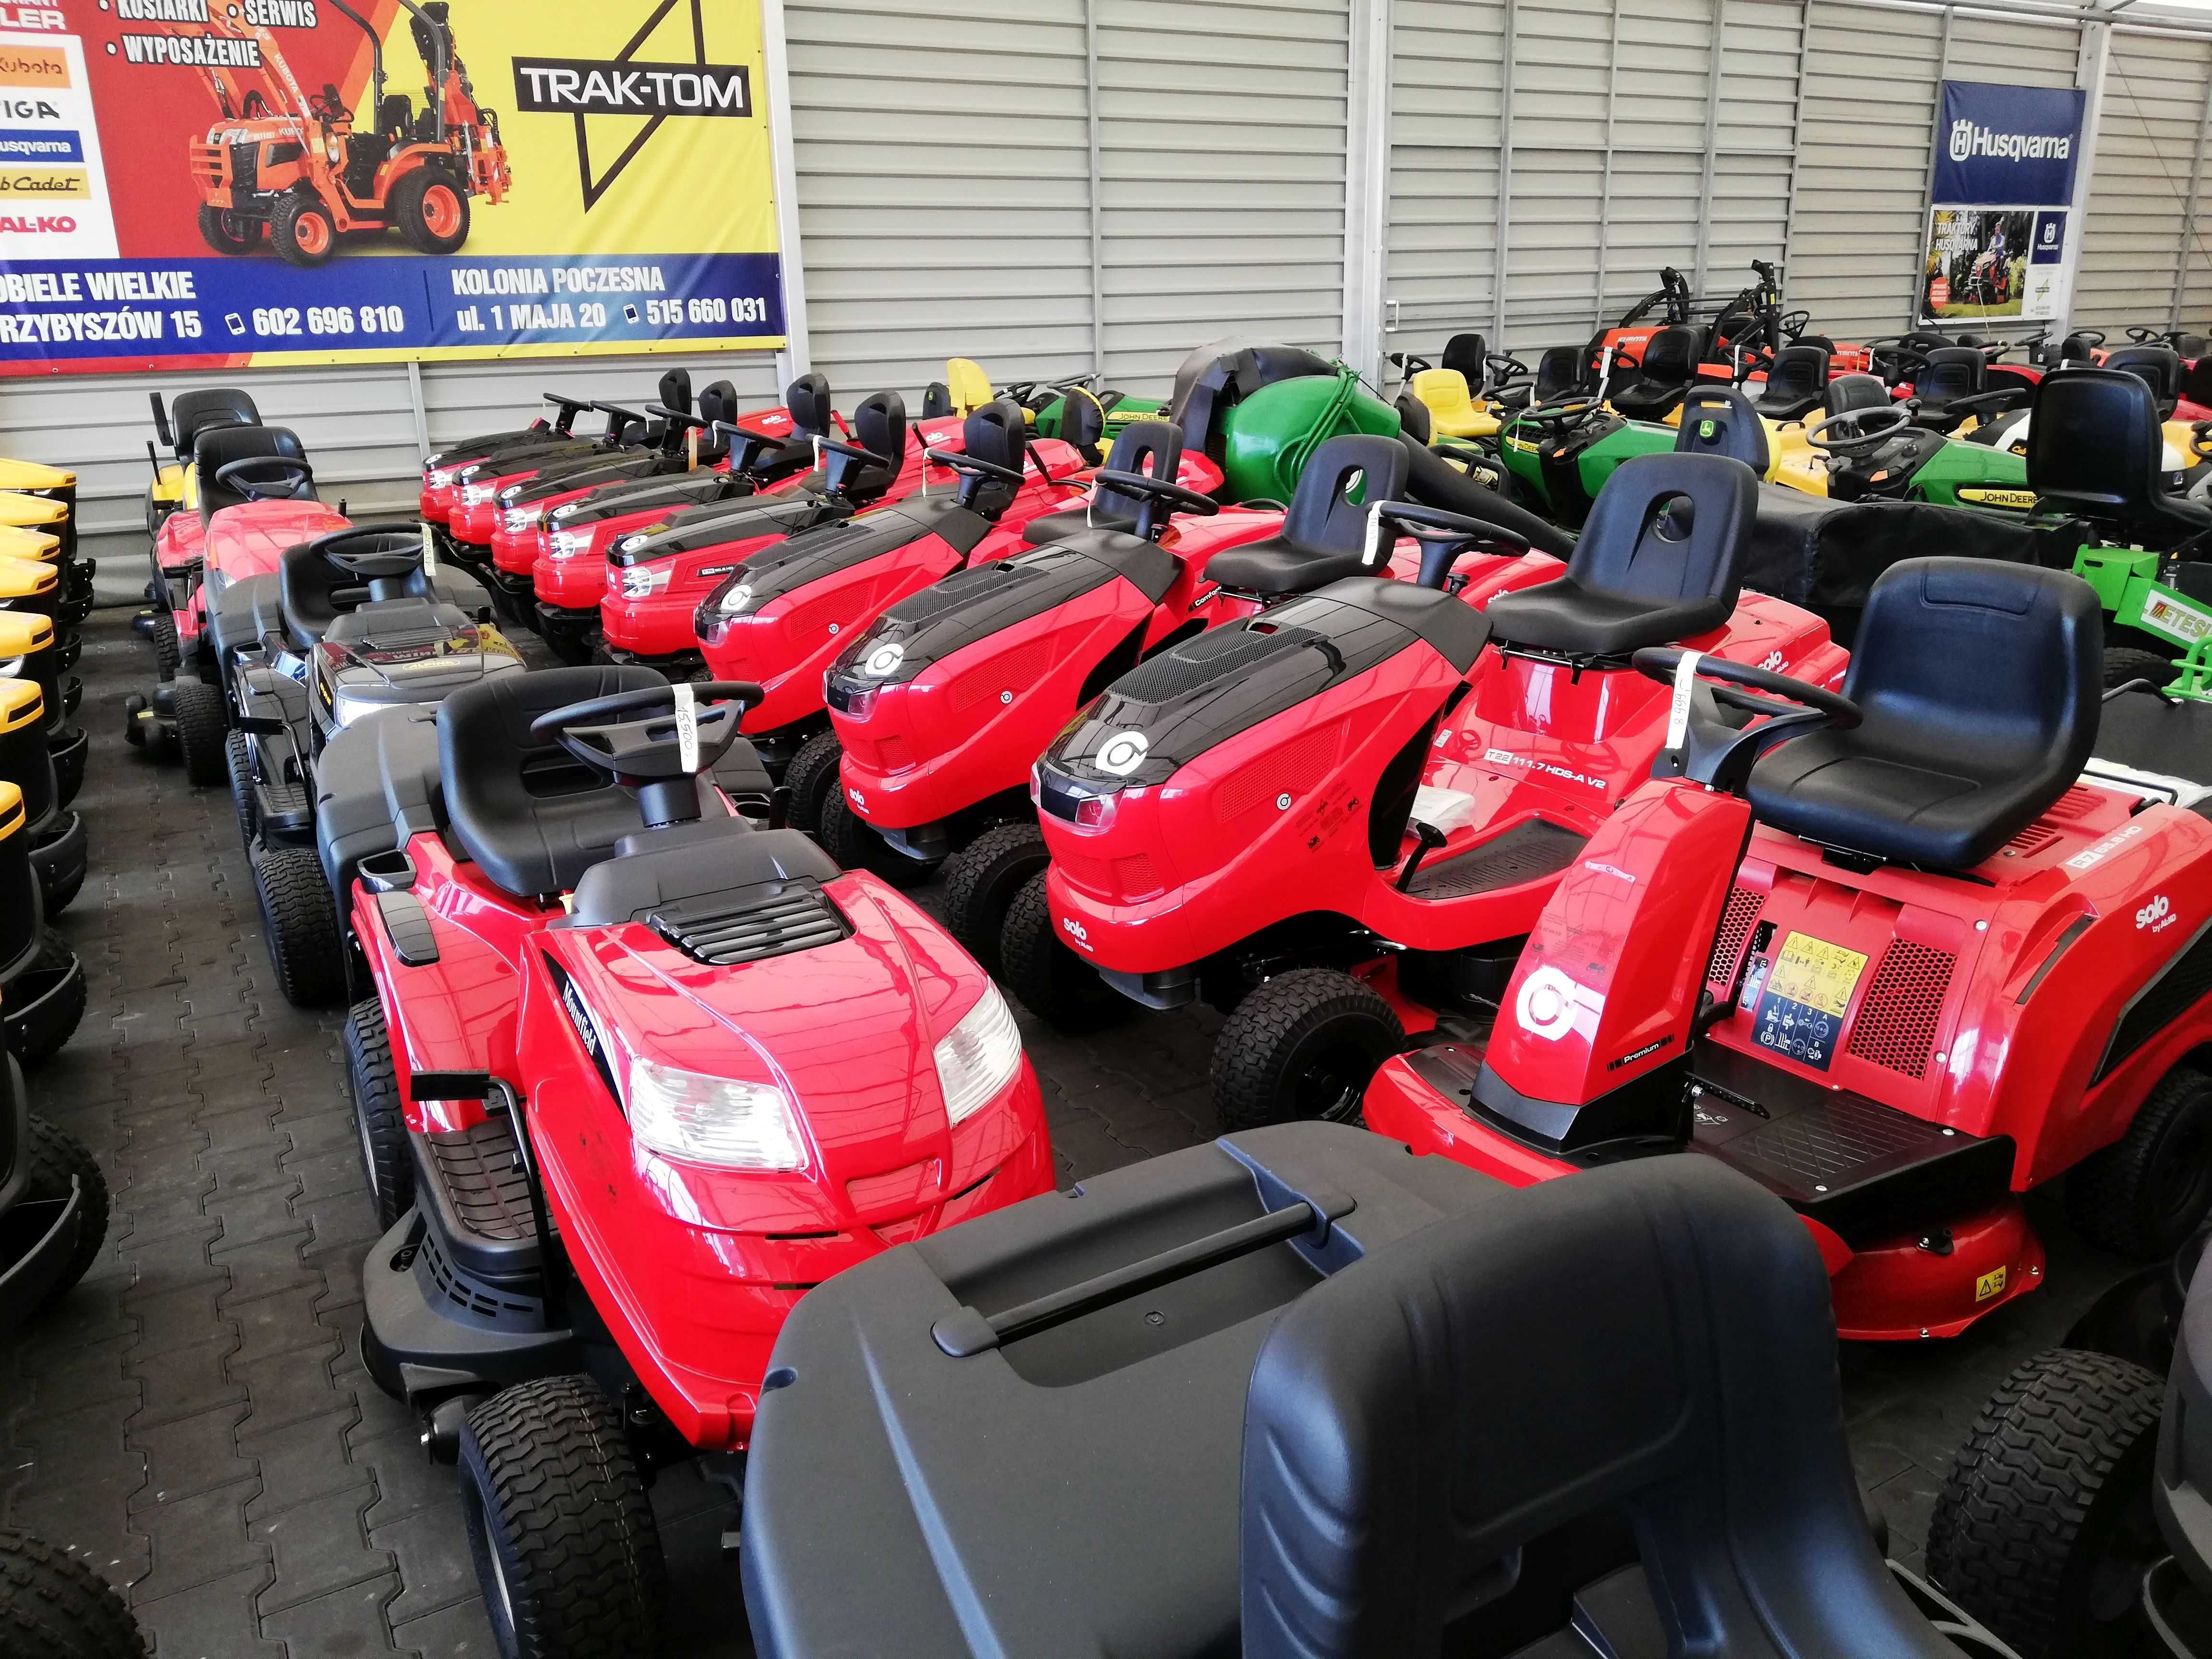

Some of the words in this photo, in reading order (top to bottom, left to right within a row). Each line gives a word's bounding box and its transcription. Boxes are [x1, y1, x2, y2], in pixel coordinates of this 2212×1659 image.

[117, 0, 209, 22] KOSIARKI
[244, 0, 317, 27] SERWIS
[123, 34, 261, 67] WYPOSAŻENIE
[274, 53, 299, 94] KUBOTA
[520, 67, 744, 108] TRAK-TOM
[0, 100, 60, 119] IGA
[1972, 126, 2069, 162] Husqvarna
[13, 176, 81, 191] Cadet
[0, 216, 76, 233] AL-KO
[1937, 222, 1976, 235] TRAKTORY
[1936, 239, 1978, 252] HUSQVARNA
[84, 271, 196, 301] WIELKIE
[451, 268, 549, 295] KOLONIA
[553, 266, 665, 293] POCZESNA
[170, 311, 202, 338] 15
[252, 308, 302, 336] 602
[308, 306, 355, 335] 696
[360, 305, 404, 333] 810
[457, 306, 485, 331] ul.
[491, 305, 503, 330] 1
[510, 304, 576, 329] MAJA
[579, 302, 606, 327] 20
[646, 299, 683, 325] 515
[688, 298, 726, 323] 660
[731, 297, 767, 322] 031
[1981, 491, 2008, 503] JOHN
[2010, 493, 2037, 504] DEERE
[2160, 605, 2212, 637] ETESI
[409, 661, 456, 669] ALPINA
[1513, 757, 1546, 770] 111.7
[1545, 765, 1585, 783] HDS-A
[1587, 776, 1606, 789] V2
[849, 788, 865, 805] solo
[2120, 825, 2143, 838] HD
[2136, 894, 2169, 929] solo
[1063, 917, 1087, 940] solo
[2152, 924, 2161, 933] by
[563, 980, 597, 1057] Mountfield
[1623, 1043, 1659, 1063] Premium
